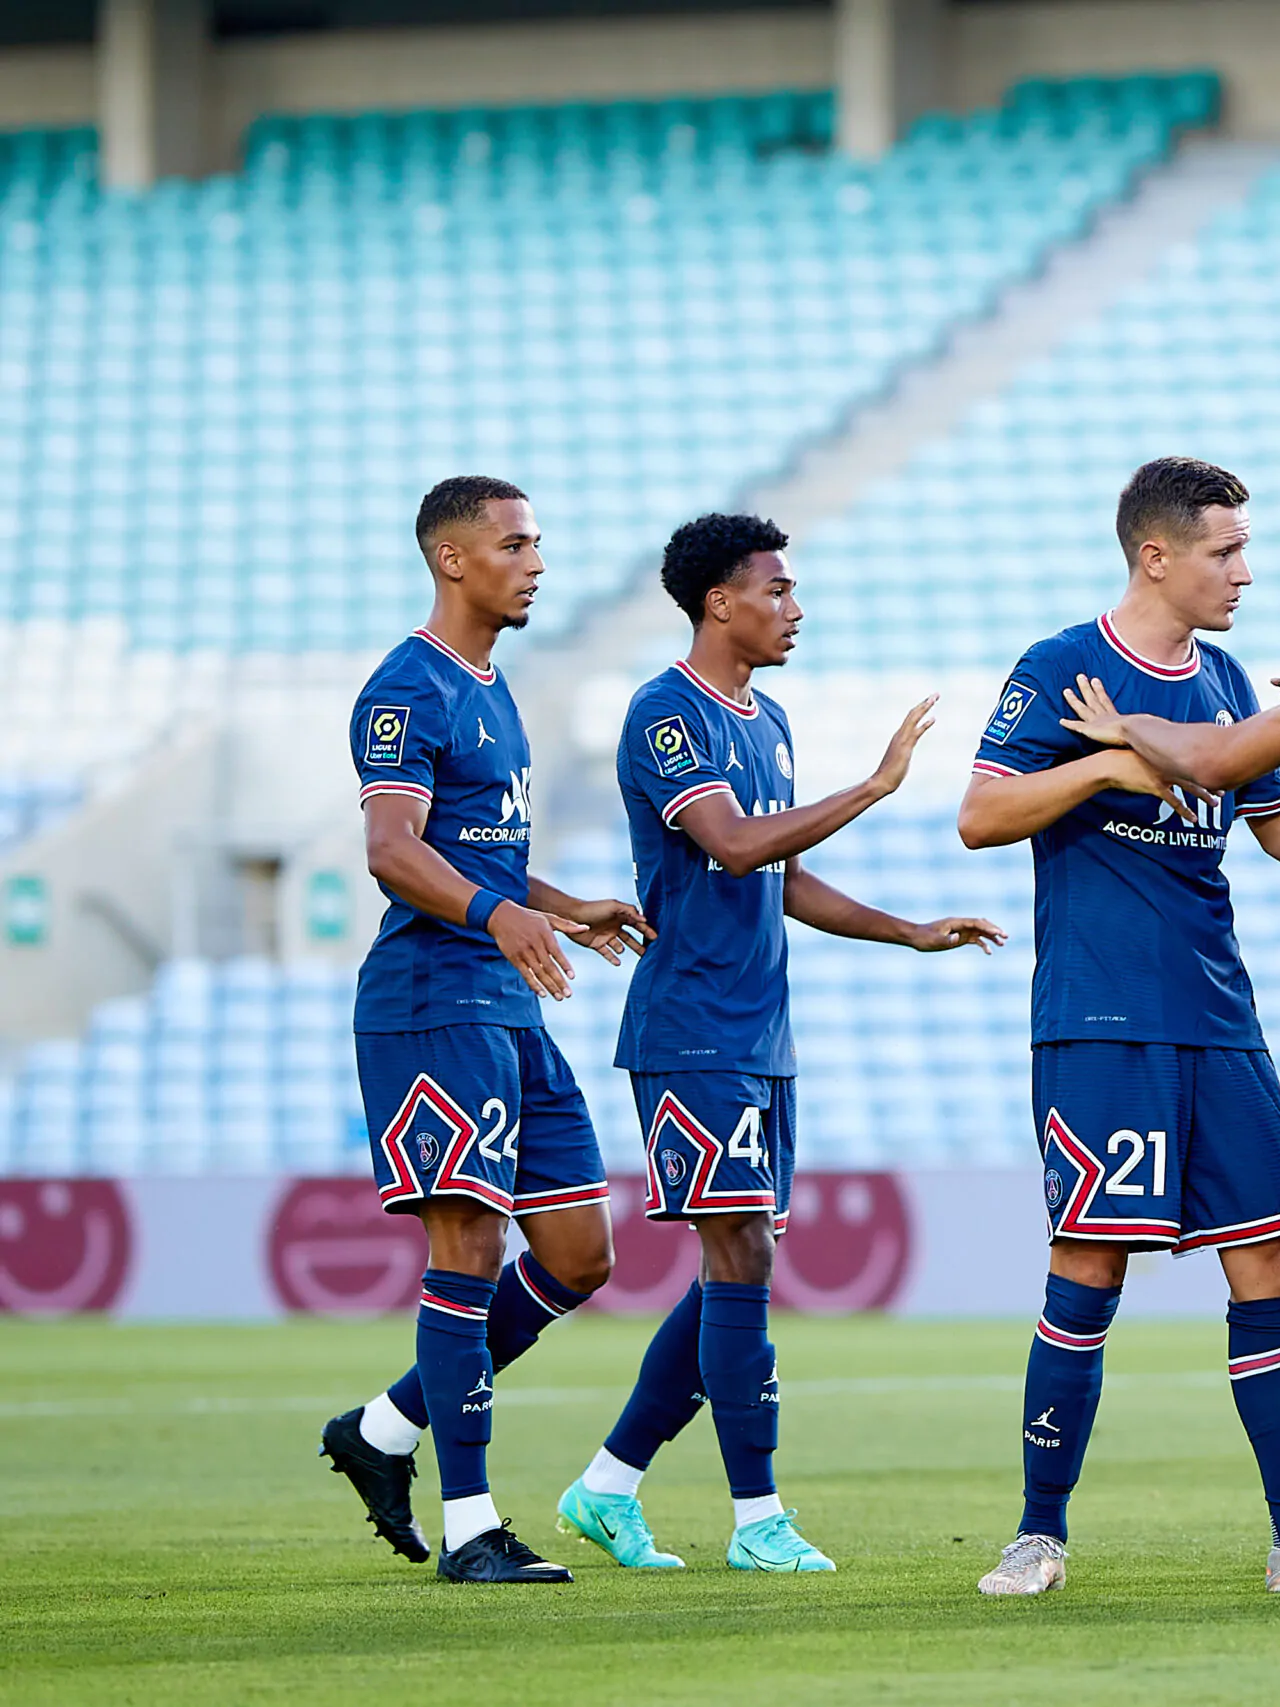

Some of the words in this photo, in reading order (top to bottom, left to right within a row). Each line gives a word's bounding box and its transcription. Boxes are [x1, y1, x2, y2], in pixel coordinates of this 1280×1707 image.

[458, 827, 509, 841] ACCOR
[509, 828, 527, 842] LIVE
[1102, 820, 1166, 845] ACCOR
[1169, 831, 1199, 847] LIVE
[1105, 1129, 1167, 1196] 21
[1024, 1430, 1061, 1448] PARIS
